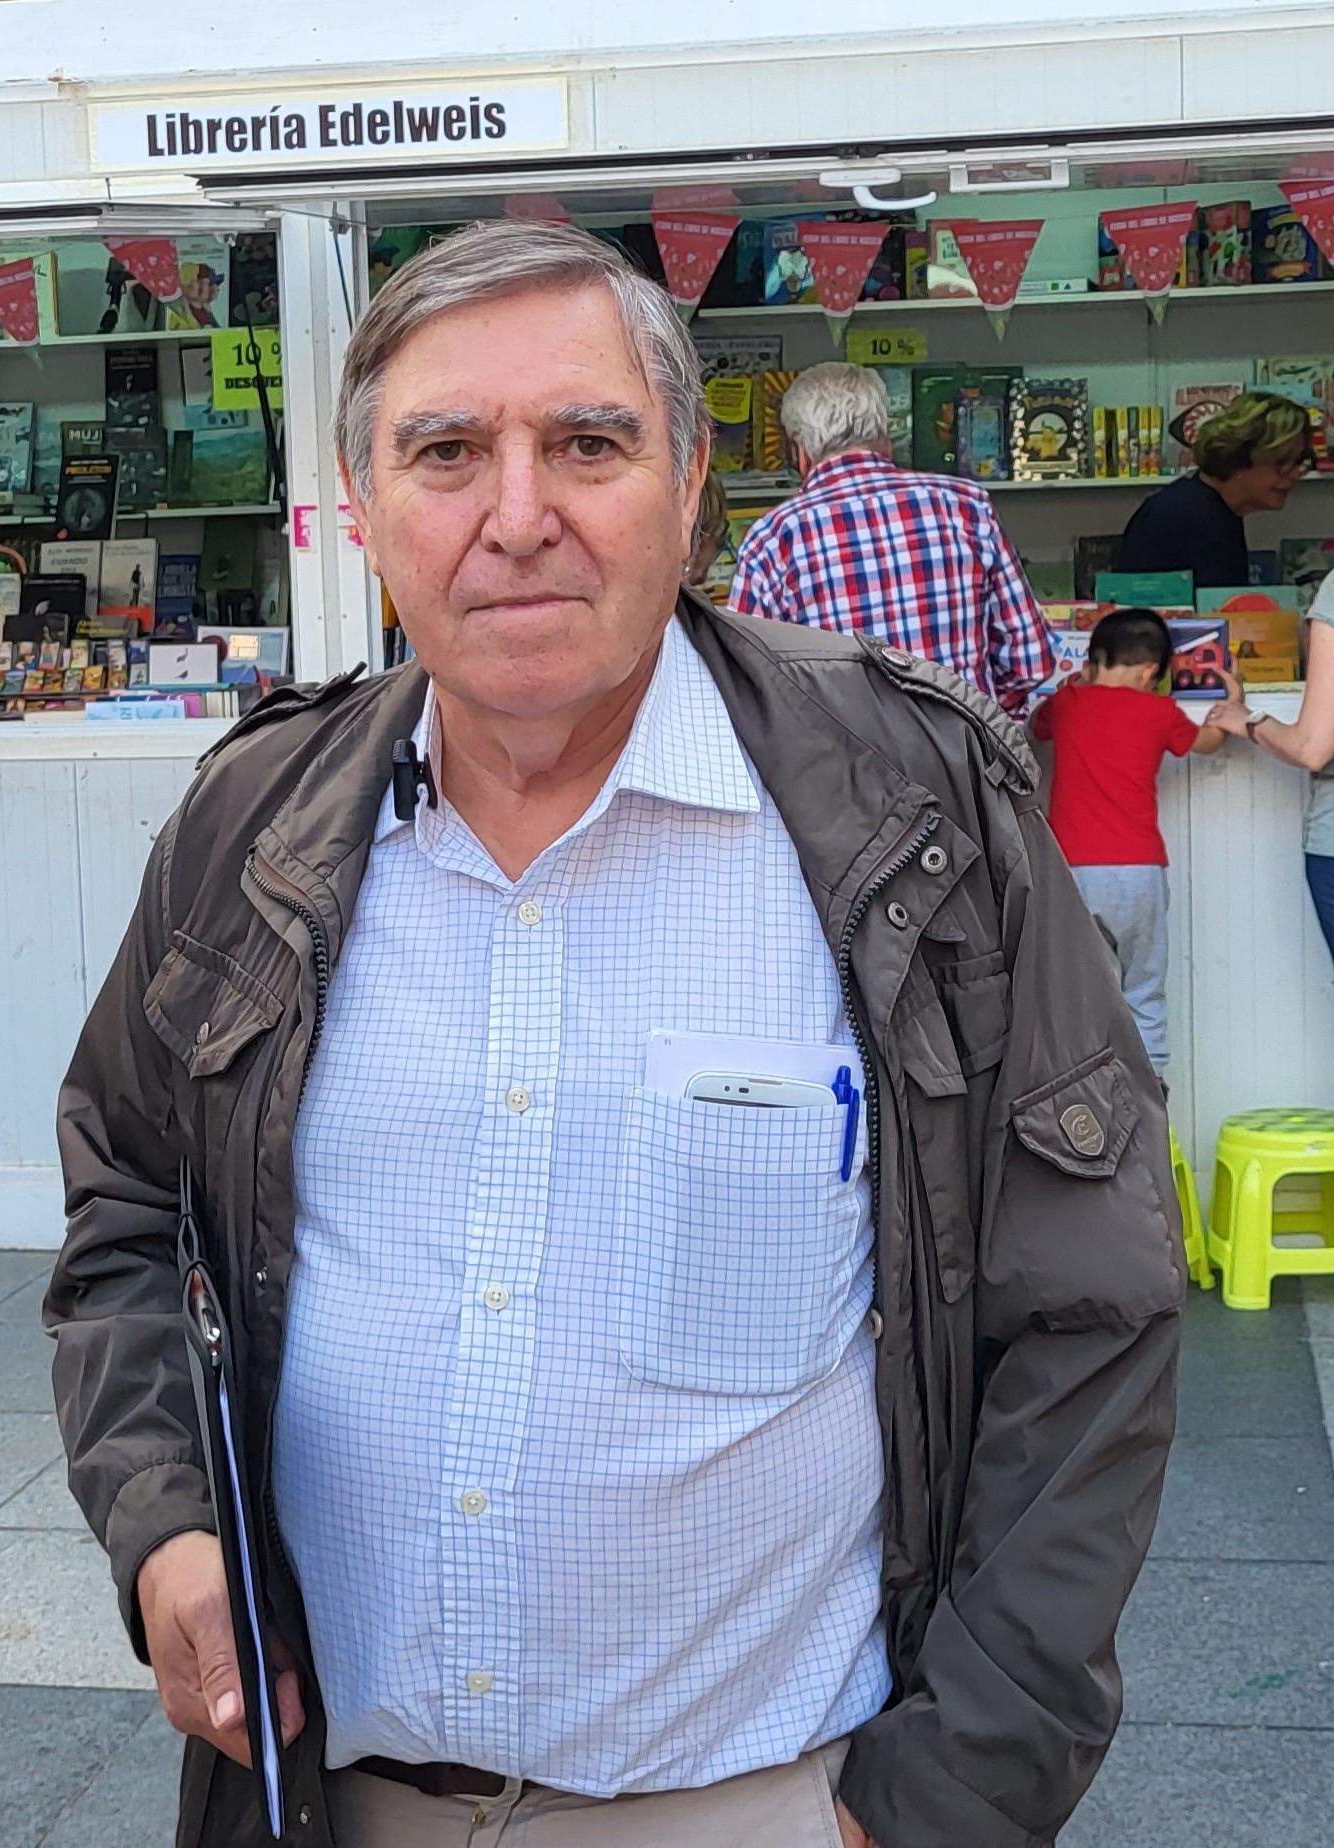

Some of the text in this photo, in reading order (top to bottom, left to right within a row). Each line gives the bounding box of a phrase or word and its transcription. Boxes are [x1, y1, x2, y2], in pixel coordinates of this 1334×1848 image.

[147, 96, 507, 157] Librería Edelweis
[231, 342, 262, 367] 10
[870, 338, 916, 356] 10 %
